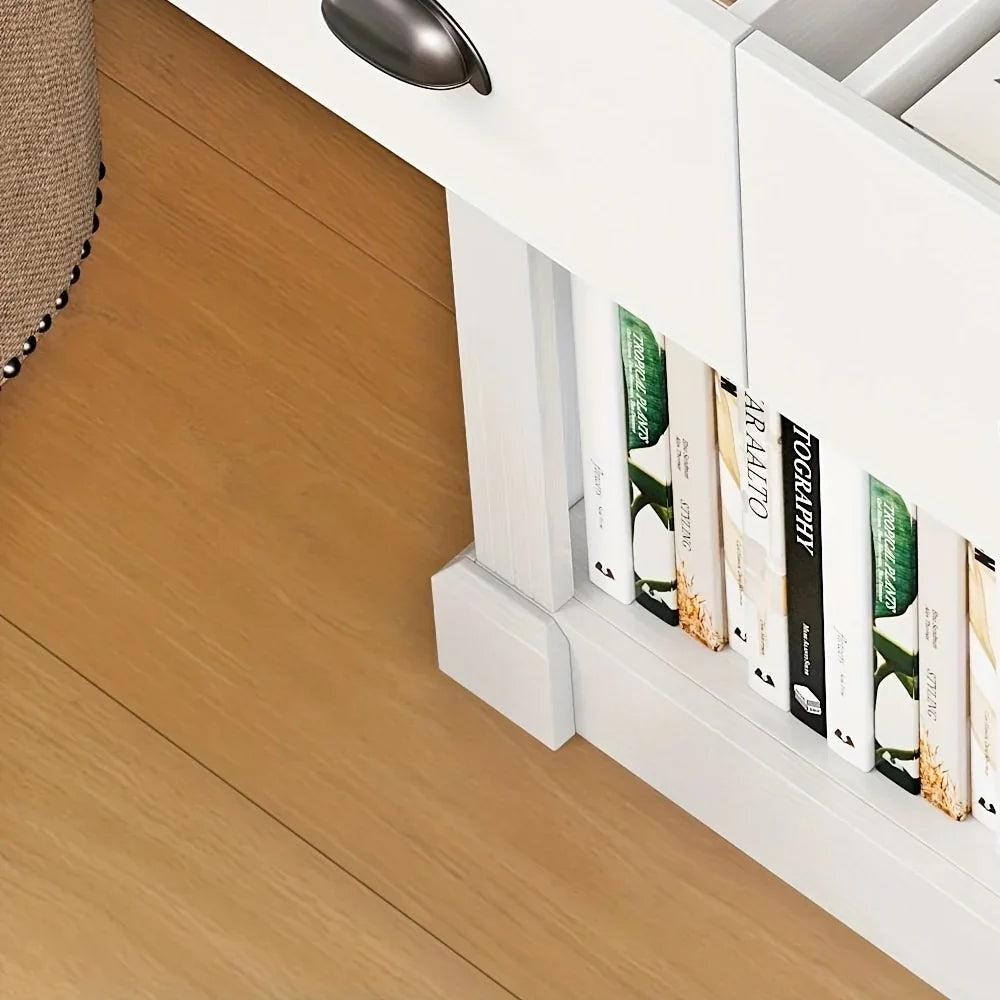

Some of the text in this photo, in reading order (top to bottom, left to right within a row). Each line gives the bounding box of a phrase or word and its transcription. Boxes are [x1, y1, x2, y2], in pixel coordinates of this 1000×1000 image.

[633, 331, 647, 396] TROPICAL
[680, 499, 691, 551] STYLING
[883, 501, 897, 613] TROPICAL PLANTS
